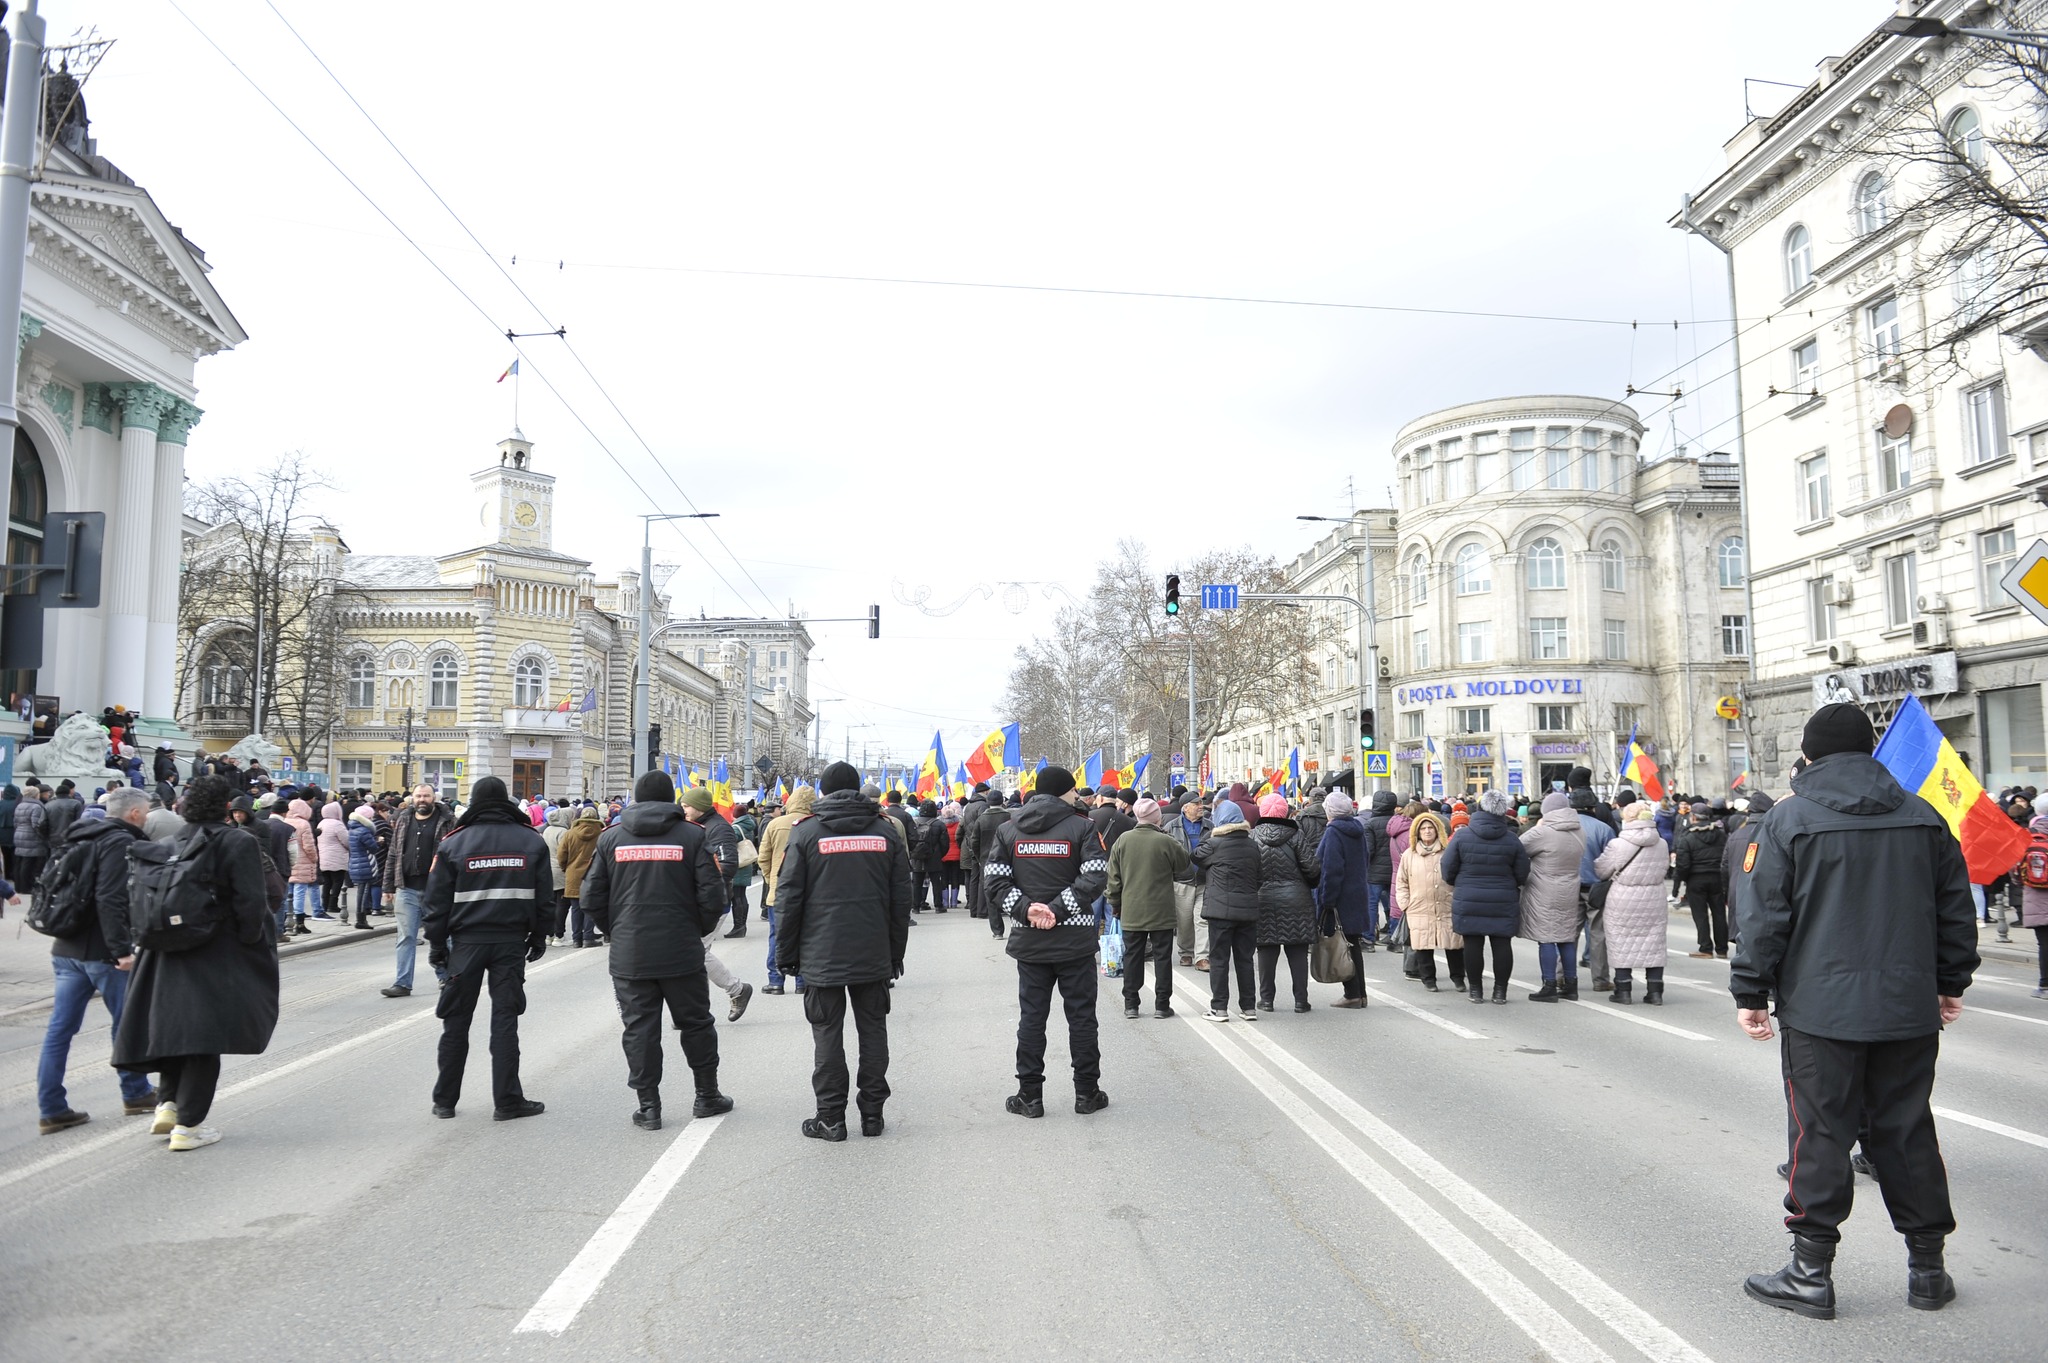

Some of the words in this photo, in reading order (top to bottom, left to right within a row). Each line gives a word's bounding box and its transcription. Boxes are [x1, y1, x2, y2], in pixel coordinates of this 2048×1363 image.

[1467, 678, 1583, 698] MOLDOVEI
[1531, 742, 1587, 754] moldcell
[820, 840, 886, 853] CARABINIERI
[1017, 843, 1068, 854] CARABINIERI
[615, 848, 683, 861] CARABINIERI
[468, 858, 524, 869] CARABINIERI
